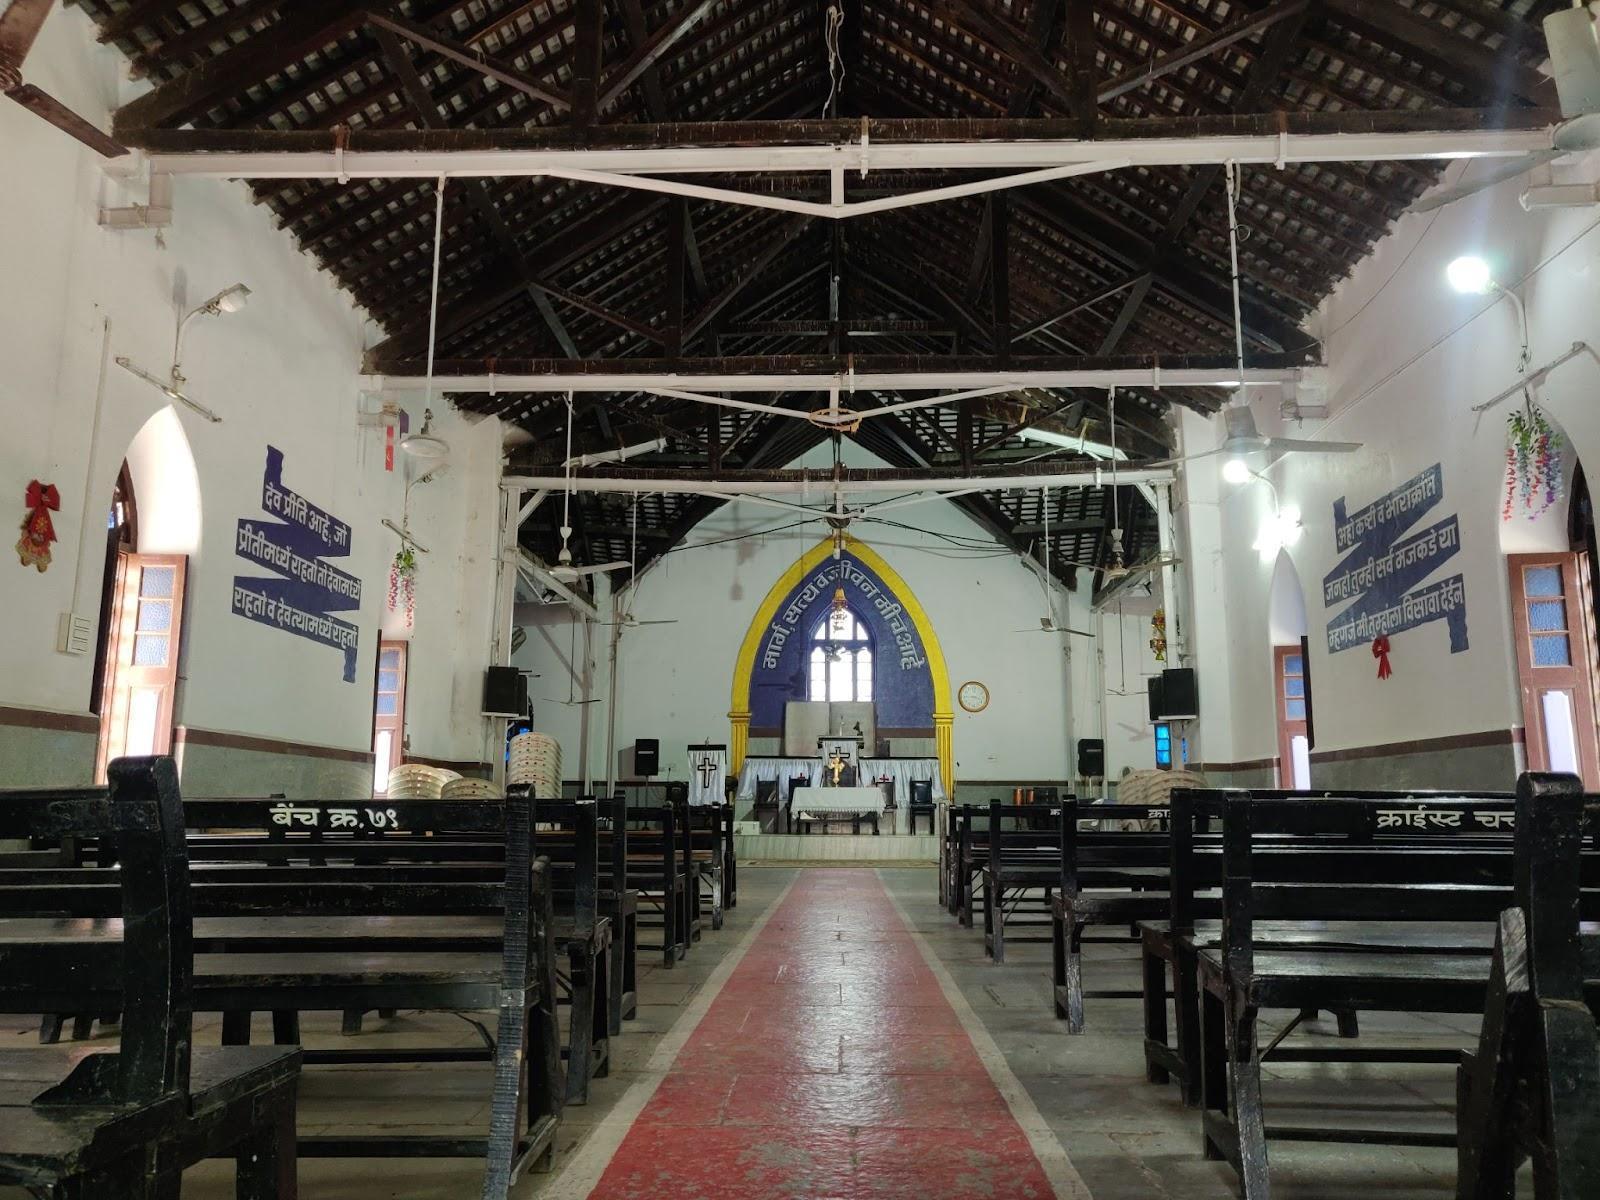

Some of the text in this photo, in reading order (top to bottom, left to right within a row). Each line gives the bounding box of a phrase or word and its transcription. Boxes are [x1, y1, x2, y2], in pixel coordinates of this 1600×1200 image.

[266, 482, 282, 510] देव
[283, 493, 308, 525] प्रीति
[334, 525, 347, 547] जो
[1337, 518, 1355, 547] अहो
[1355, 504, 1376, 536] कष्टी
[1377, 504, 1386, 524] व
[291, 554, 317, 583] राहतो
[1351, 557, 1375, 595] तुम्ही
[1376, 545, 1395, 579] सर्व
[1395, 529, 1437, 571] मजकडे
[1438, 524, 1456, 548] या
[234, 586, 267, 618] राहतो
[268, 599, 277, 620] व
[782, 582, 821, 625] सत्य
[813, 572, 830, 589] व
[824, 560, 881, 600] जीवन
[1355, 611, 1368, 637] मी
[269, 803, 320, 827] बेंच
[1376, 804, 1465, 829] क्राईस्ट
